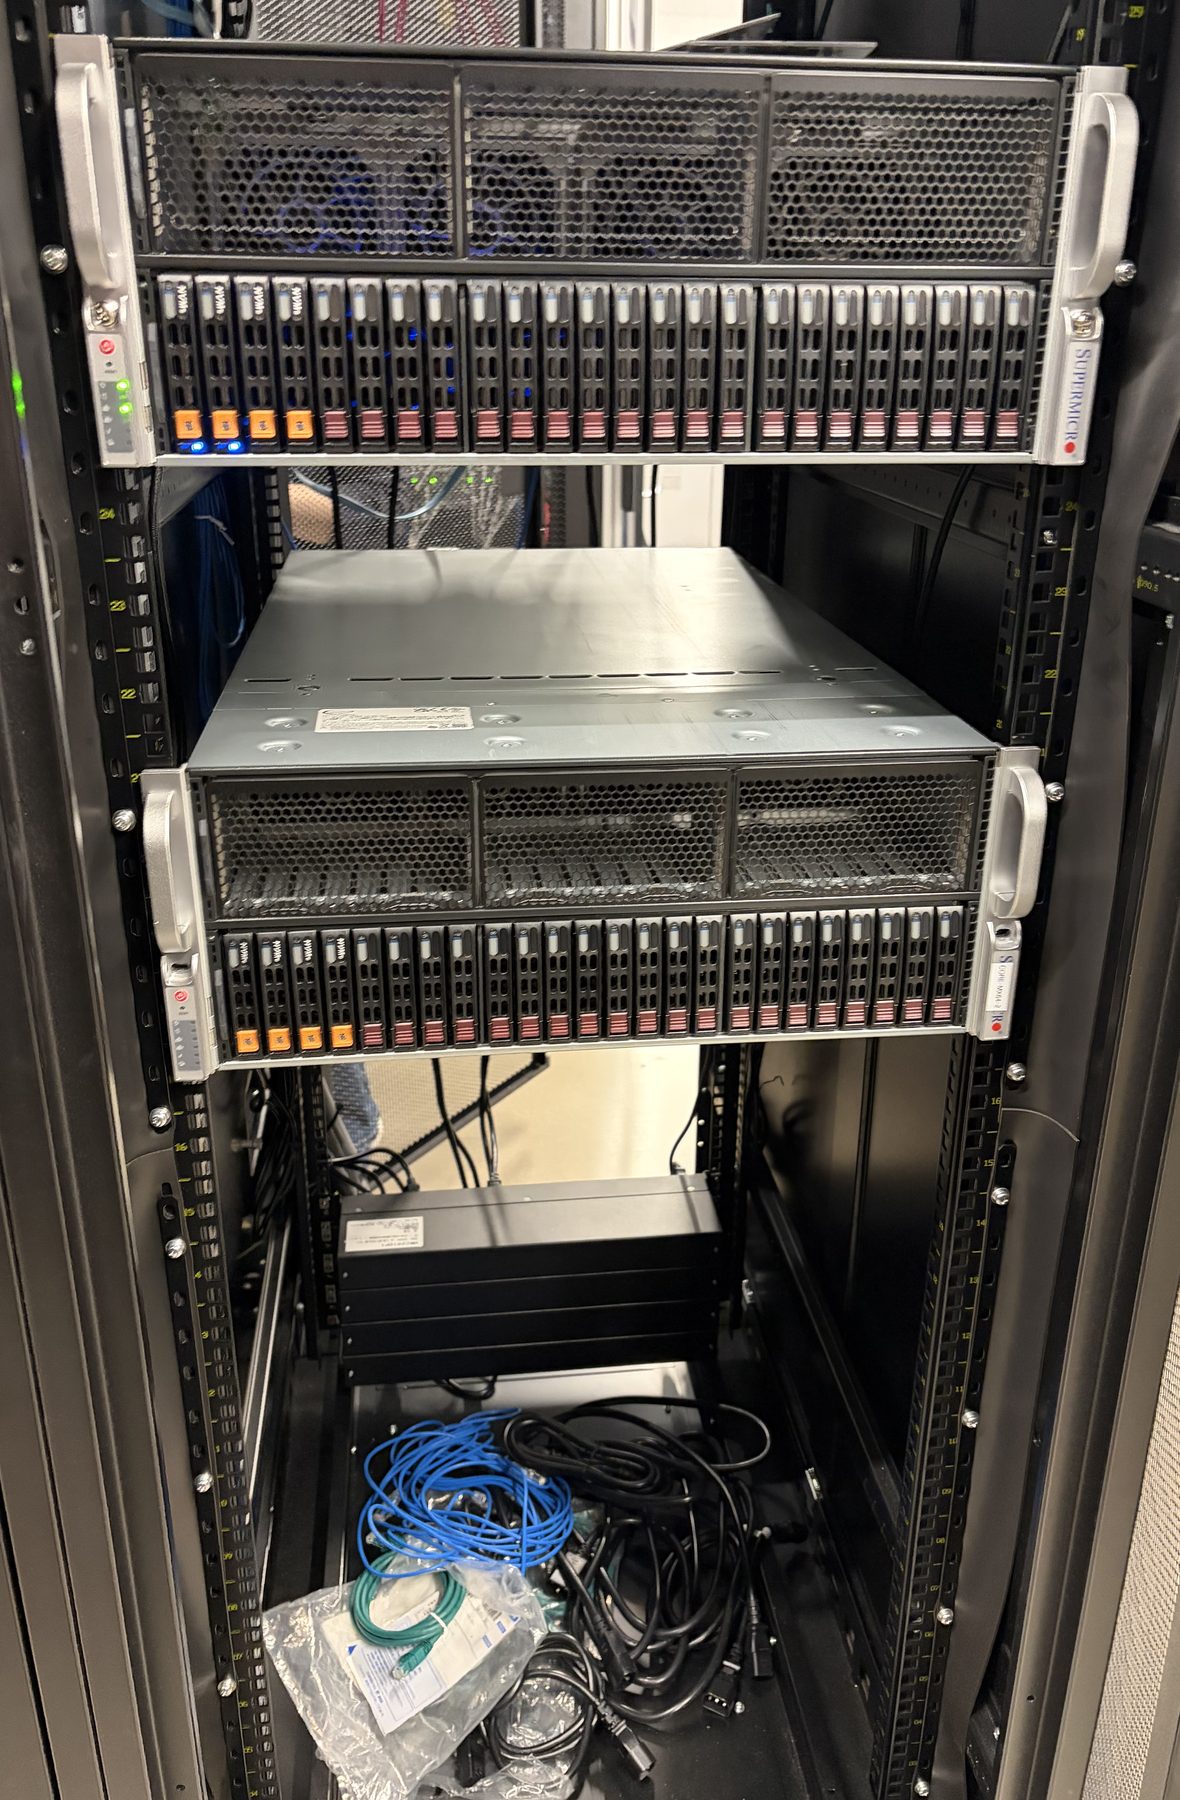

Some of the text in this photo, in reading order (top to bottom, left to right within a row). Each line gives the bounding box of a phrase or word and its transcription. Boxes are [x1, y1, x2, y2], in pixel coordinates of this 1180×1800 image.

[1055, 586, 1068, 597] 23
[109, 599, 127, 612] 23
[1044, 667, 1058, 679] 22
[120, 688, 137, 700] 22
[130, 773, 141, 784] 2
[991, 1097, 1001, 1105] 16
[983, 1159, 994, 1167] 15
[976, 1219, 987, 1227] 14
[194, 1270, 203, 1279] 4
[201, 1330, 209, 1339] 3
[207, 1389, 217, 1397] 2
[935, 1537, 946, 1545] 08
[929, 1585, 941, 1593] 07
